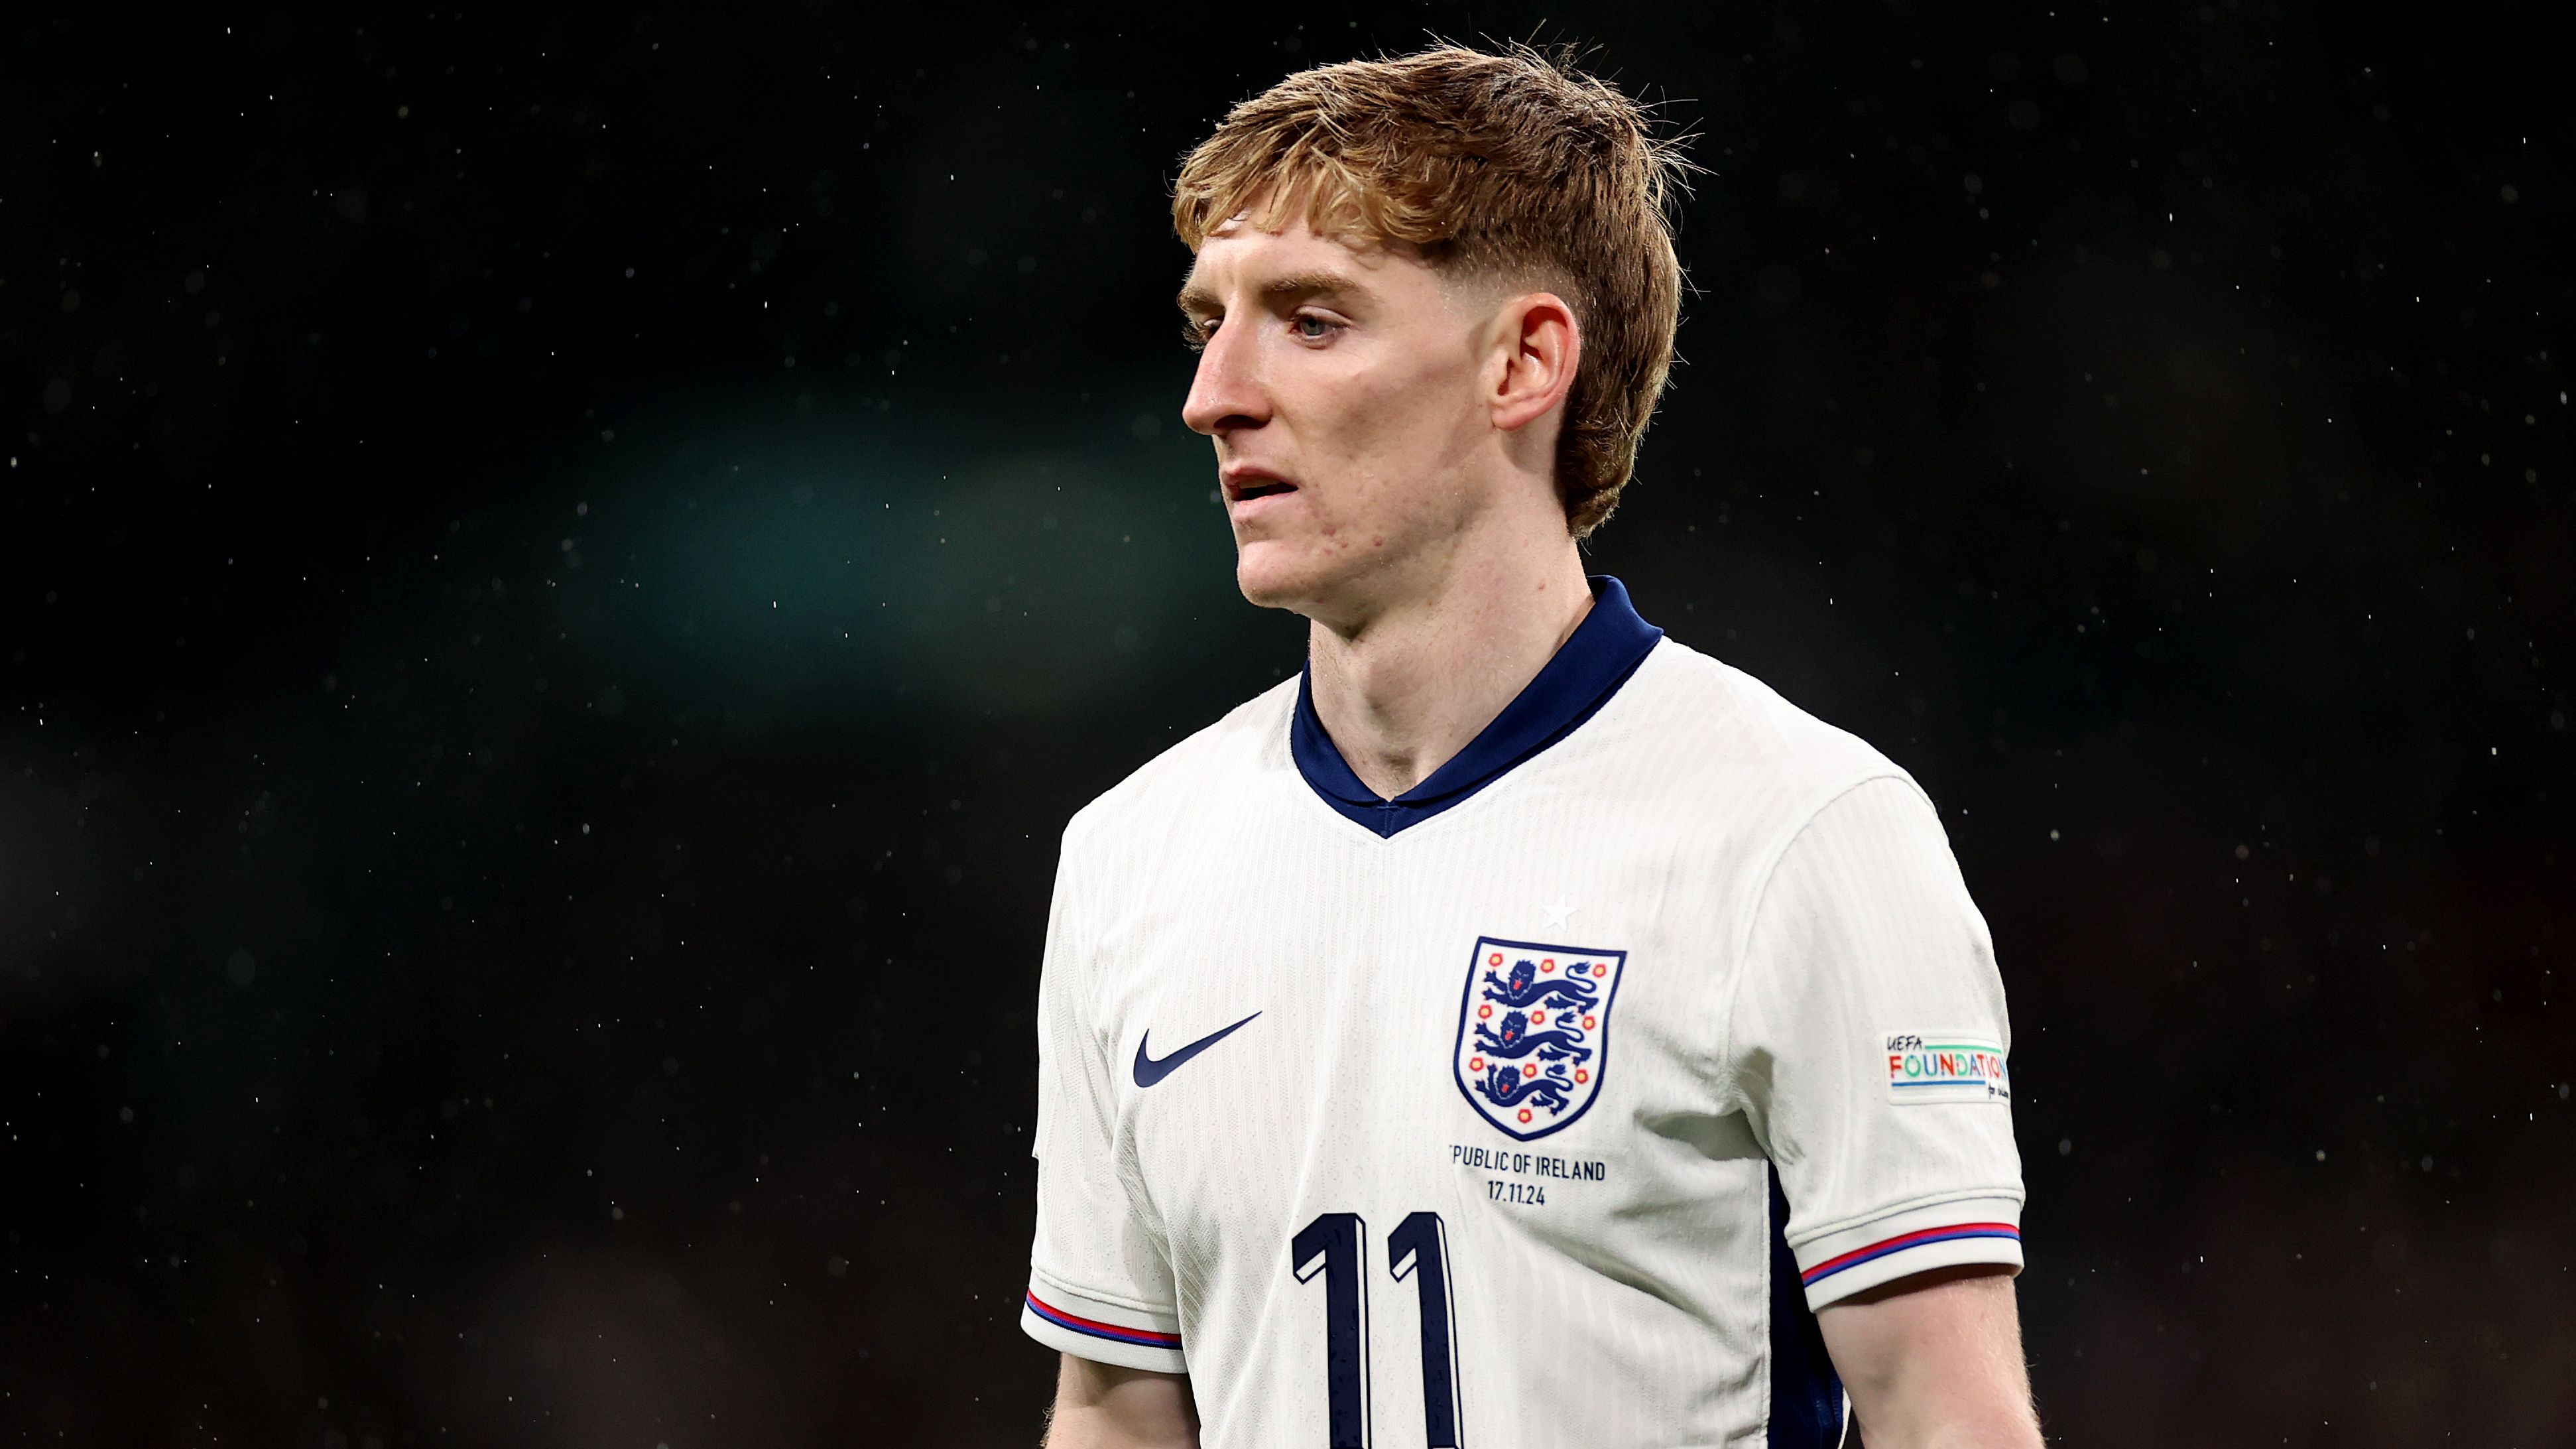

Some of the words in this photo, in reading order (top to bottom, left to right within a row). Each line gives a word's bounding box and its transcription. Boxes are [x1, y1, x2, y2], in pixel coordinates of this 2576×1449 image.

[1887, 1035, 1922, 1051] UEFA
[1889, 1053, 2008, 1080] FOUNDATION
[1449, 1145, 1508, 1170] PUBLIC
[1513, 1154, 1531, 1174] OF
[1536, 1156, 1605, 1181] IRELAND
[1487, 1180, 1546, 1206] 17.11.24
[1292, 1212, 1464, 1449] 11
